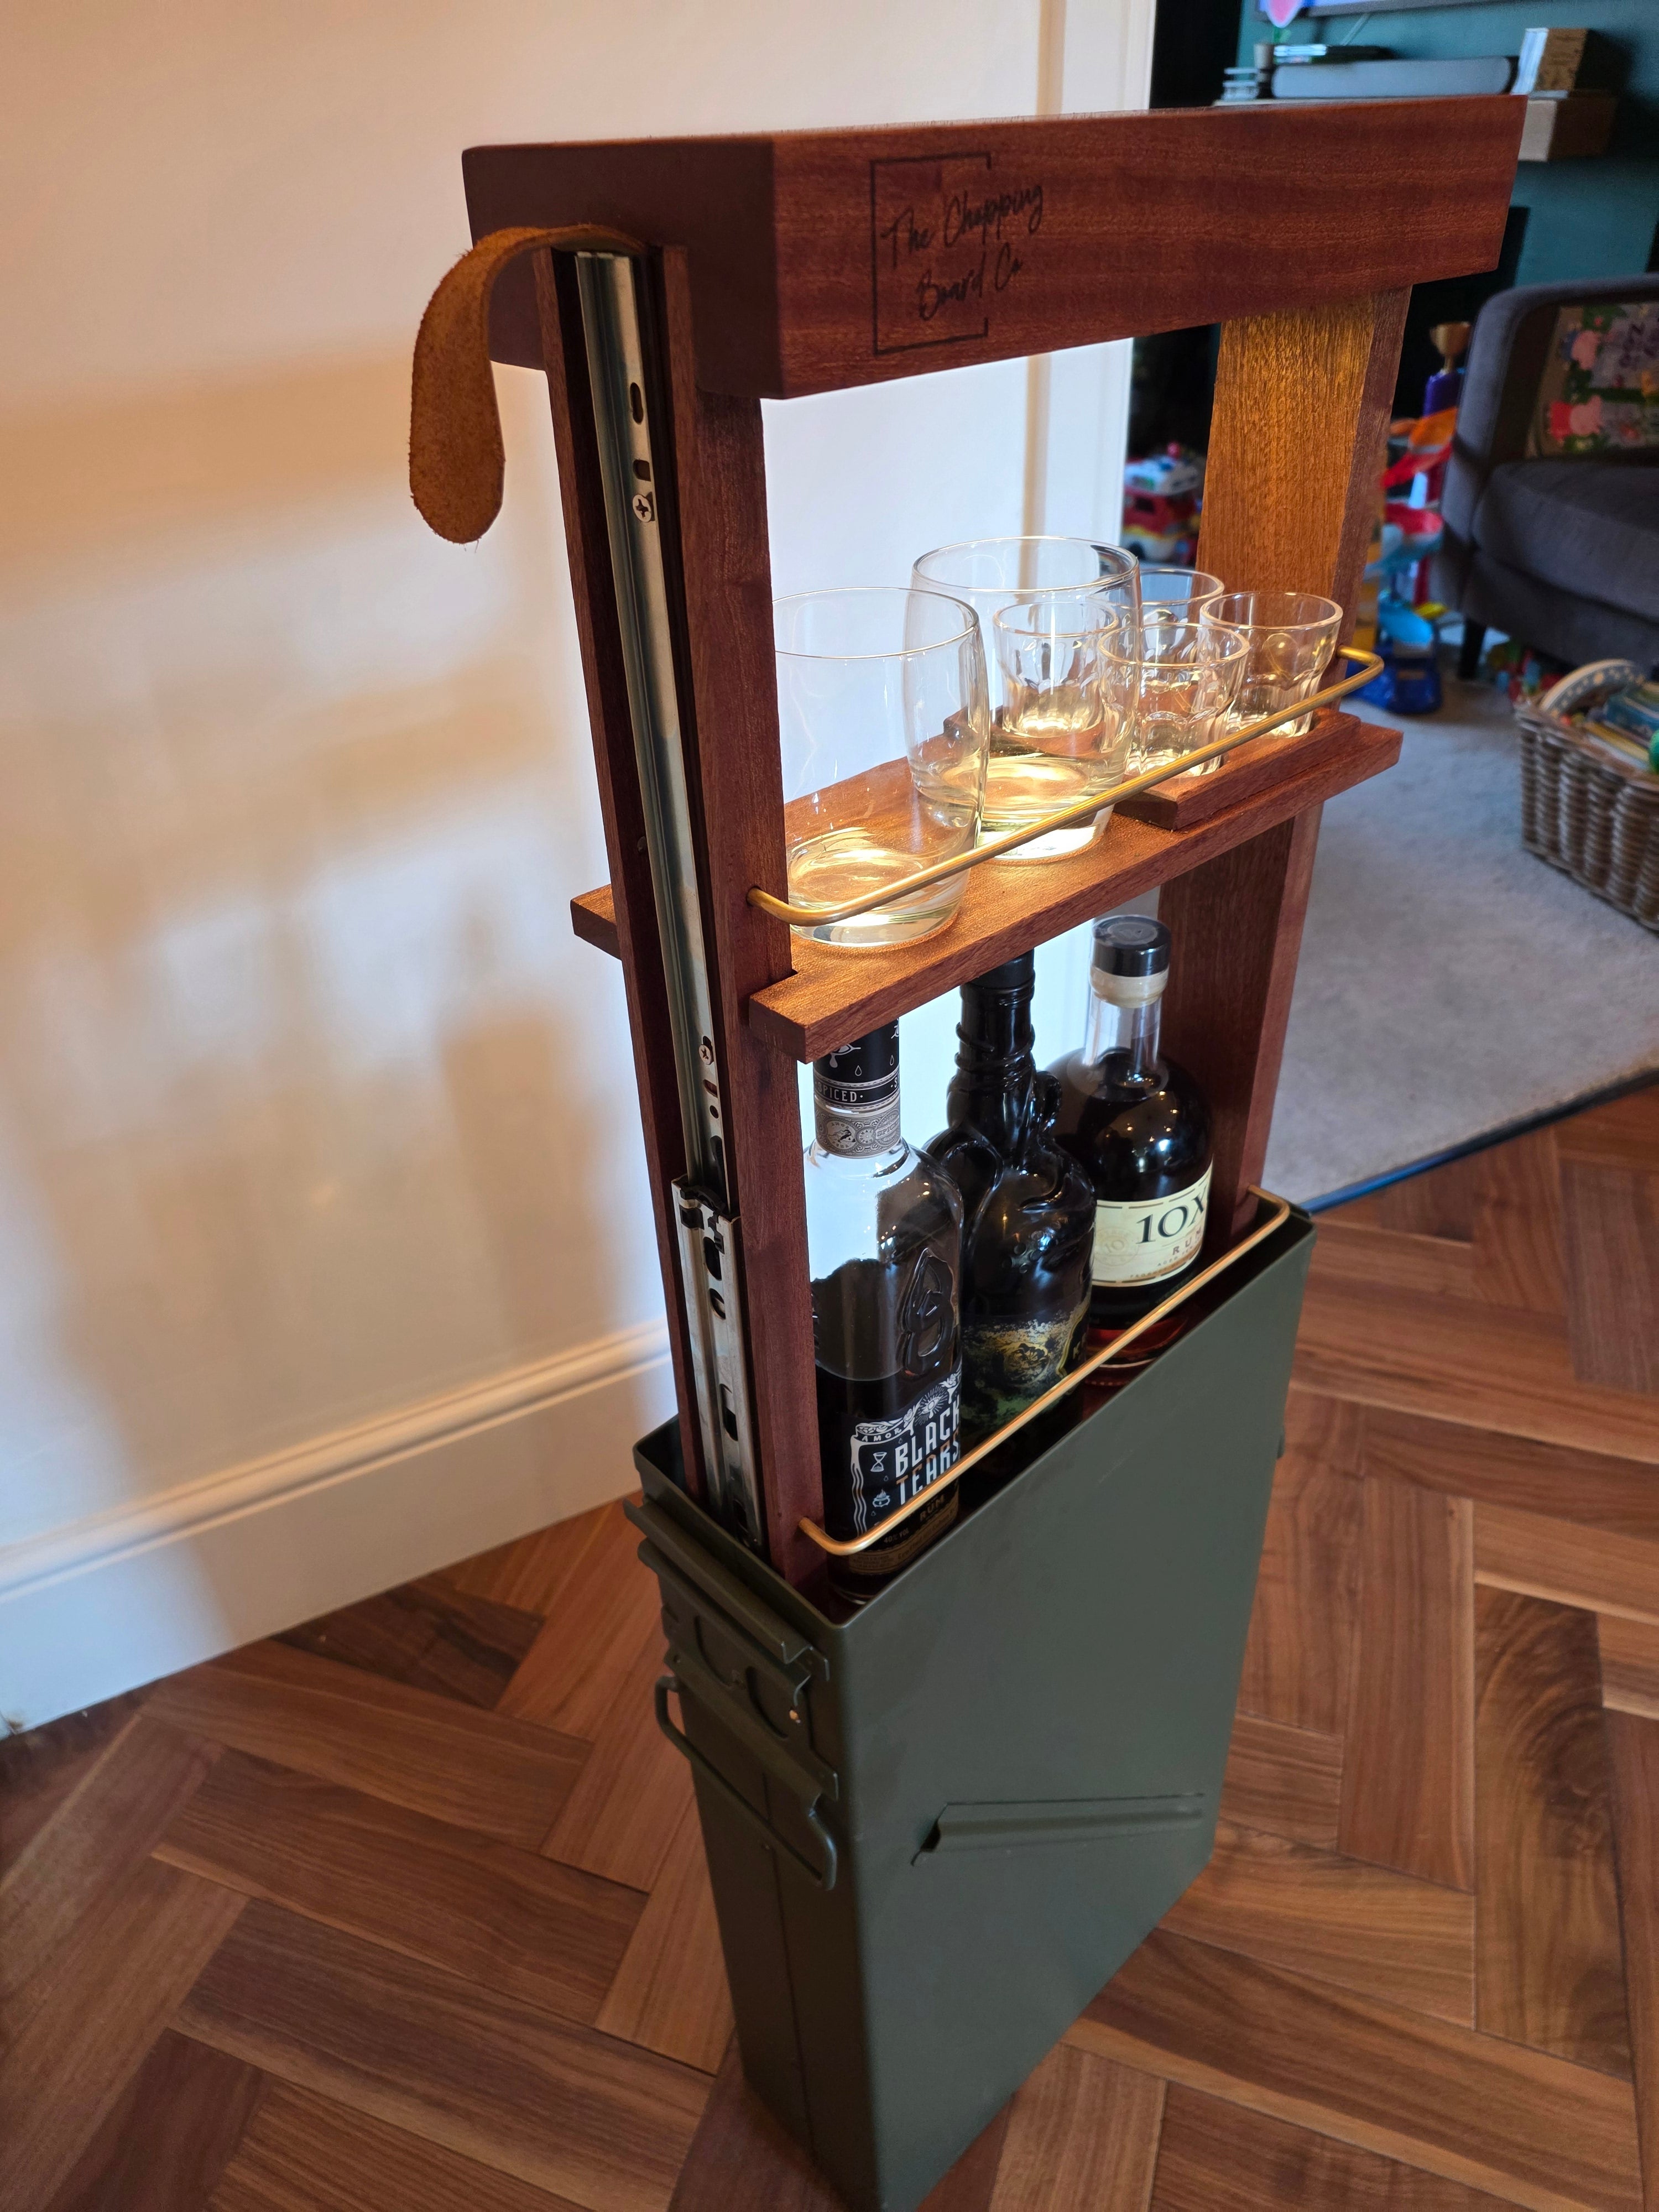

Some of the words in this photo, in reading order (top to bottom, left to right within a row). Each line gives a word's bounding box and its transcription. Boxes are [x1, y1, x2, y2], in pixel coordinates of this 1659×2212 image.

[880, 206, 936, 270] The
[943, 185, 1044, 247] Chopping
[916, 252, 986, 321] Board
[862, 1427, 902, 1442] AMOR
[895, 1395, 959, 1478] BLACK
[896, 1429, 959, 1505] TEARS
